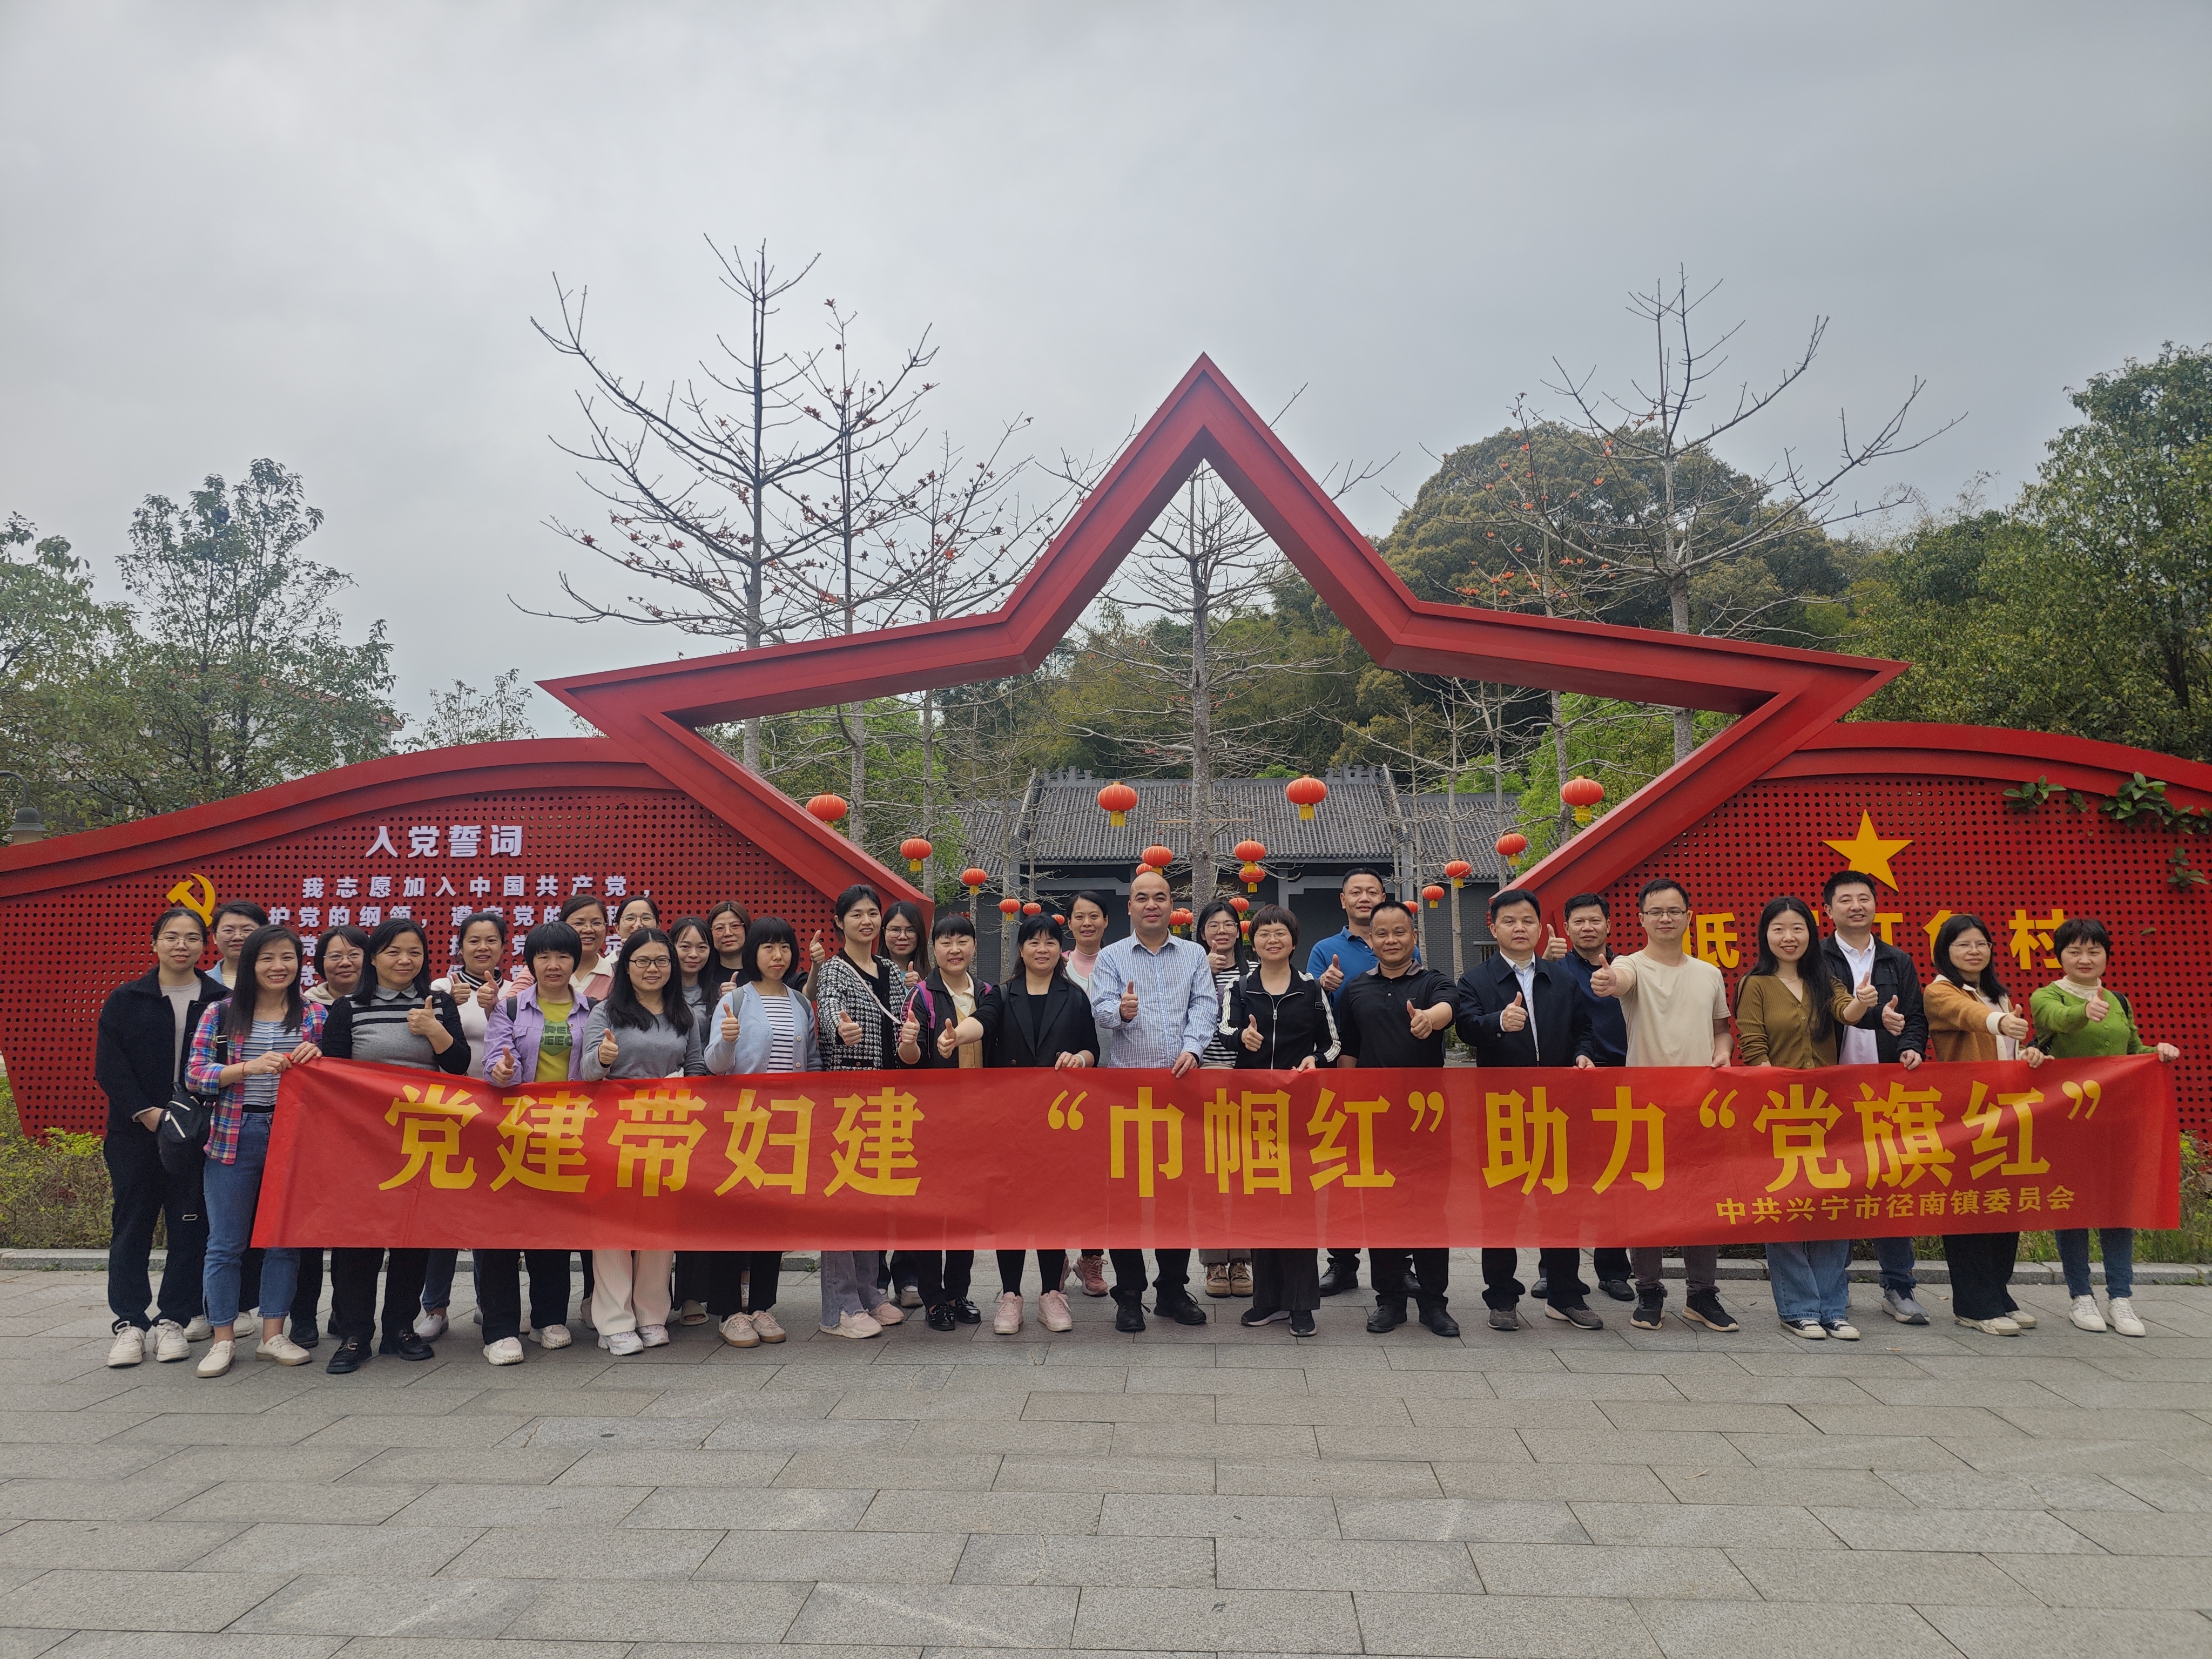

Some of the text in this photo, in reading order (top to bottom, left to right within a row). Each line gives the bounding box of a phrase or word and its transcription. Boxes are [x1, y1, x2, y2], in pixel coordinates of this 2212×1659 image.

[366, 825, 523, 859] 入党誓词
[377, 1083, 926, 1197] 党建带妇建
[1715, 1184, 2075, 1225] 中共兴宁市径南镇委员会
